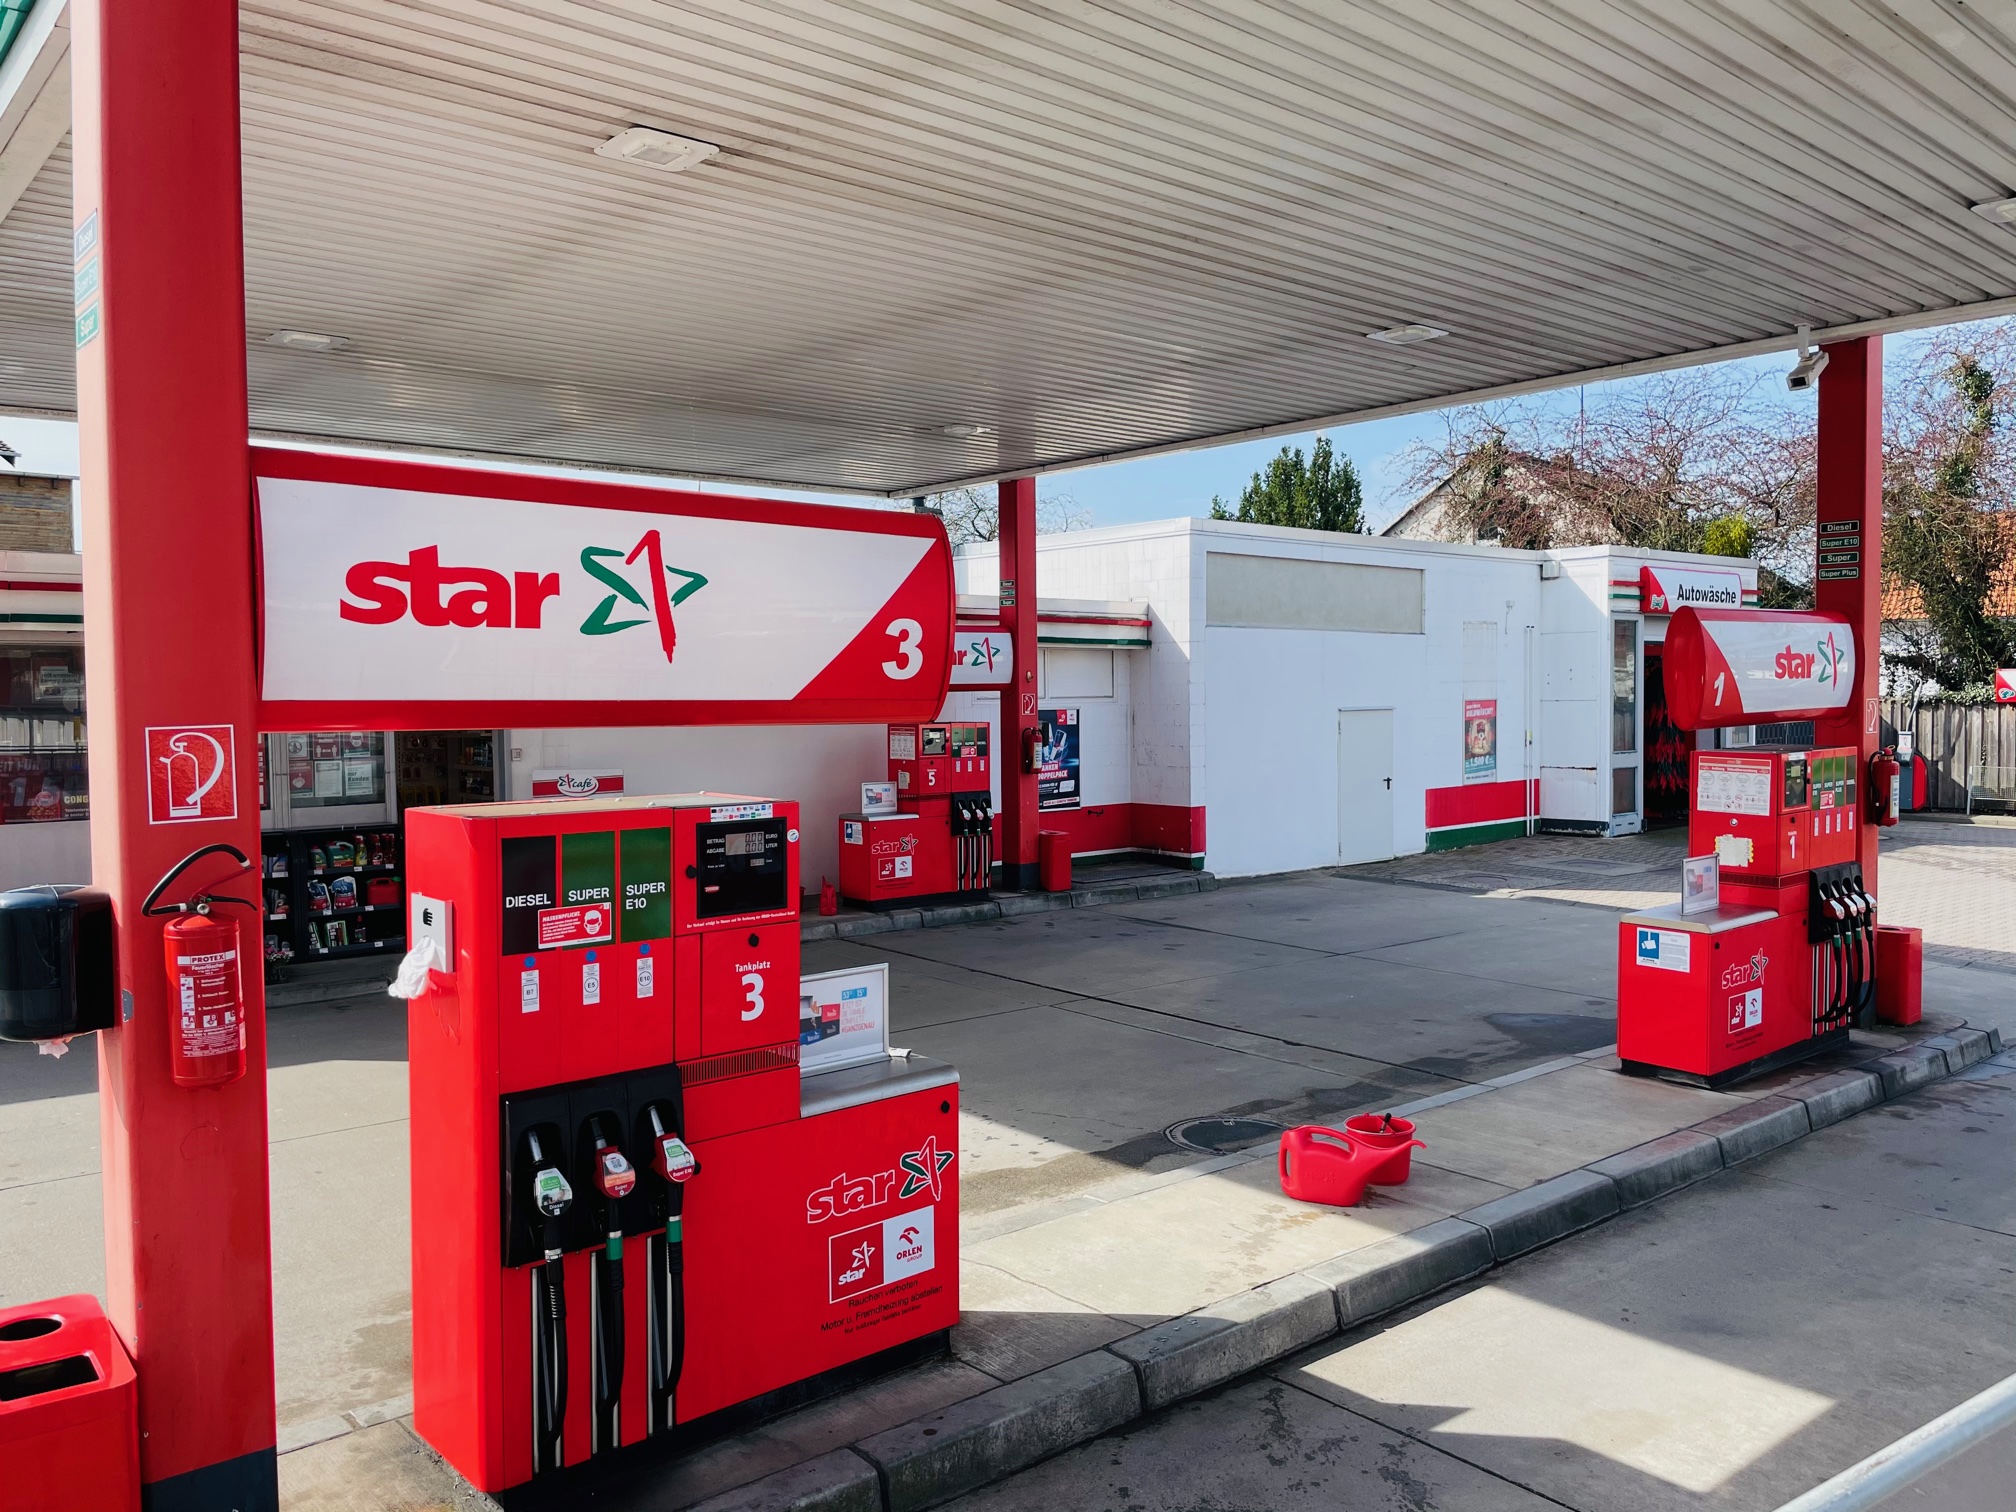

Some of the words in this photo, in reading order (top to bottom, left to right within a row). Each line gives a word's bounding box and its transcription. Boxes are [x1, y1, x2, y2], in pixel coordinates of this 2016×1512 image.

[1827, 523, 1852, 531] Diesel
[1822, 540, 1843, 548] Super
[1827, 554, 1851, 563] Super
[340, 545, 560, 629] star
[1677, 584, 1736, 604] Autowäsche
[882, 617, 923, 680] 3
[1775, 644, 1815, 679] star
[1713, 672, 1725, 706] 1
[572, 778, 593, 791] café
[928, 772, 936, 786] 5
[872, 840, 899, 854] star
[1789, 836, 1796, 859] 1
[568, 887, 610, 902] SUPER
[626, 882, 665, 896] SUPER
[506, 894, 551, 908] DIESEL
[626, 898, 647, 909] E10
[192, 954, 224, 963] PROTEX
[735, 960, 770, 973] Tankplatz
[1722, 963, 1750, 990] star
[741, 973, 765, 1022] 3
[807, 1169, 895, 1224] star
[549, 1202, 564, 1210] Diesel
[896, 1245, 922, 1260] ORLEN
[907, 1253, 922, 1263] GROUP
[838, 1267, 866, 1285] star
[848, 1291, 883, 1308] Rauchen
[885, 1280, 918, 1296] verboten
[821, 1318, 845, 1332] Motor
[855, 1298, 909, 1321] Fremdheizung
[911, 1285, 943, 1302] abstellen
